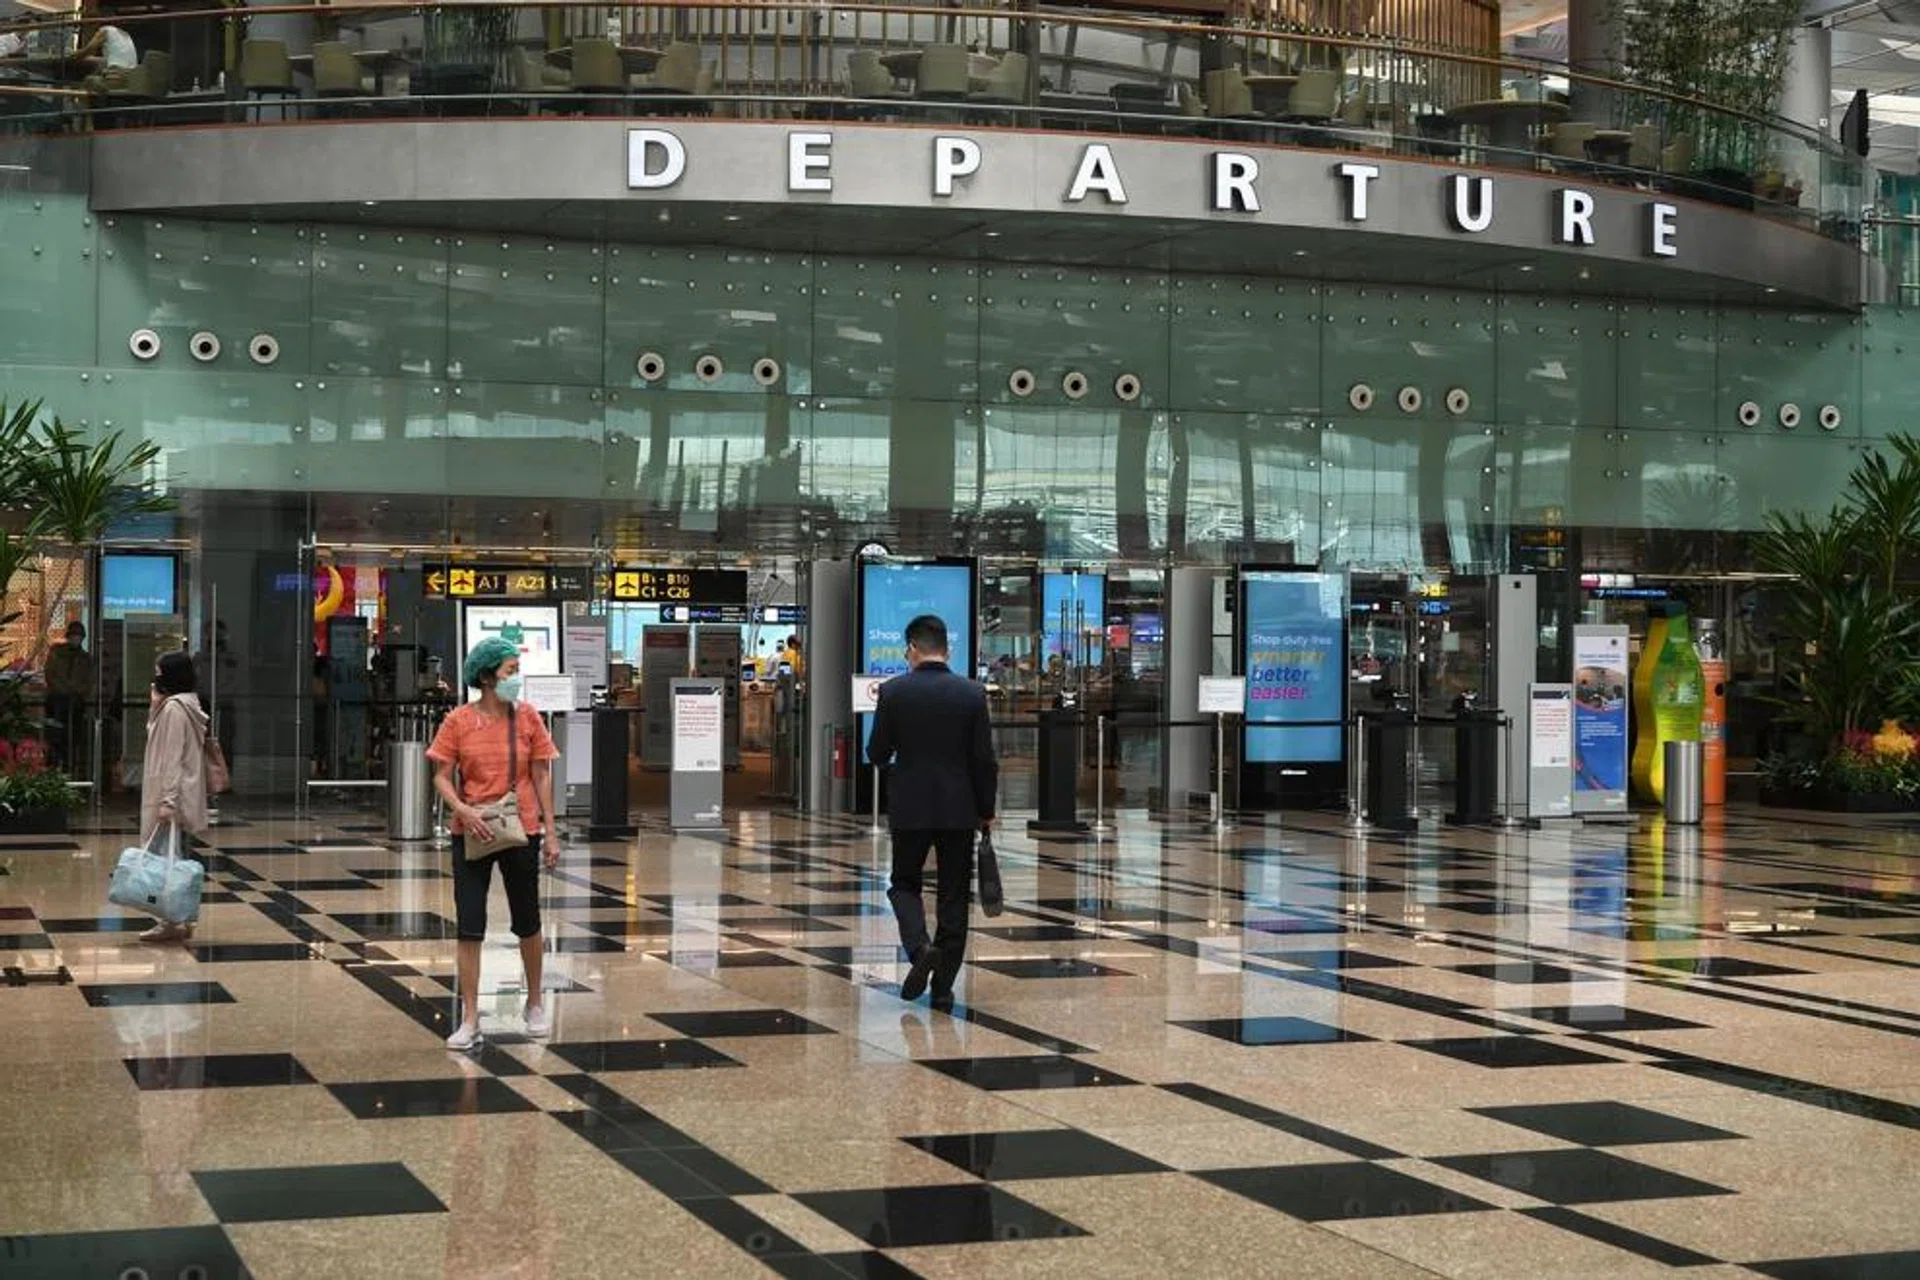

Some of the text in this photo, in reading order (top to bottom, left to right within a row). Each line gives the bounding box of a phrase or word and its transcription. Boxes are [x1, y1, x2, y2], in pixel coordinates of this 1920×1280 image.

[626, 128, 1678, 257] DEPARTURE
[477, 575, 499, 590] A1
[515, 575, 546, 590] A21
[667, 573, 690, 585] B10
[641, 585, 657, 598] C1
[667, 586, 690, 599] C26
[868, 629, 901, 643] Shop
[1251, 633, 1281, 647] Shop
